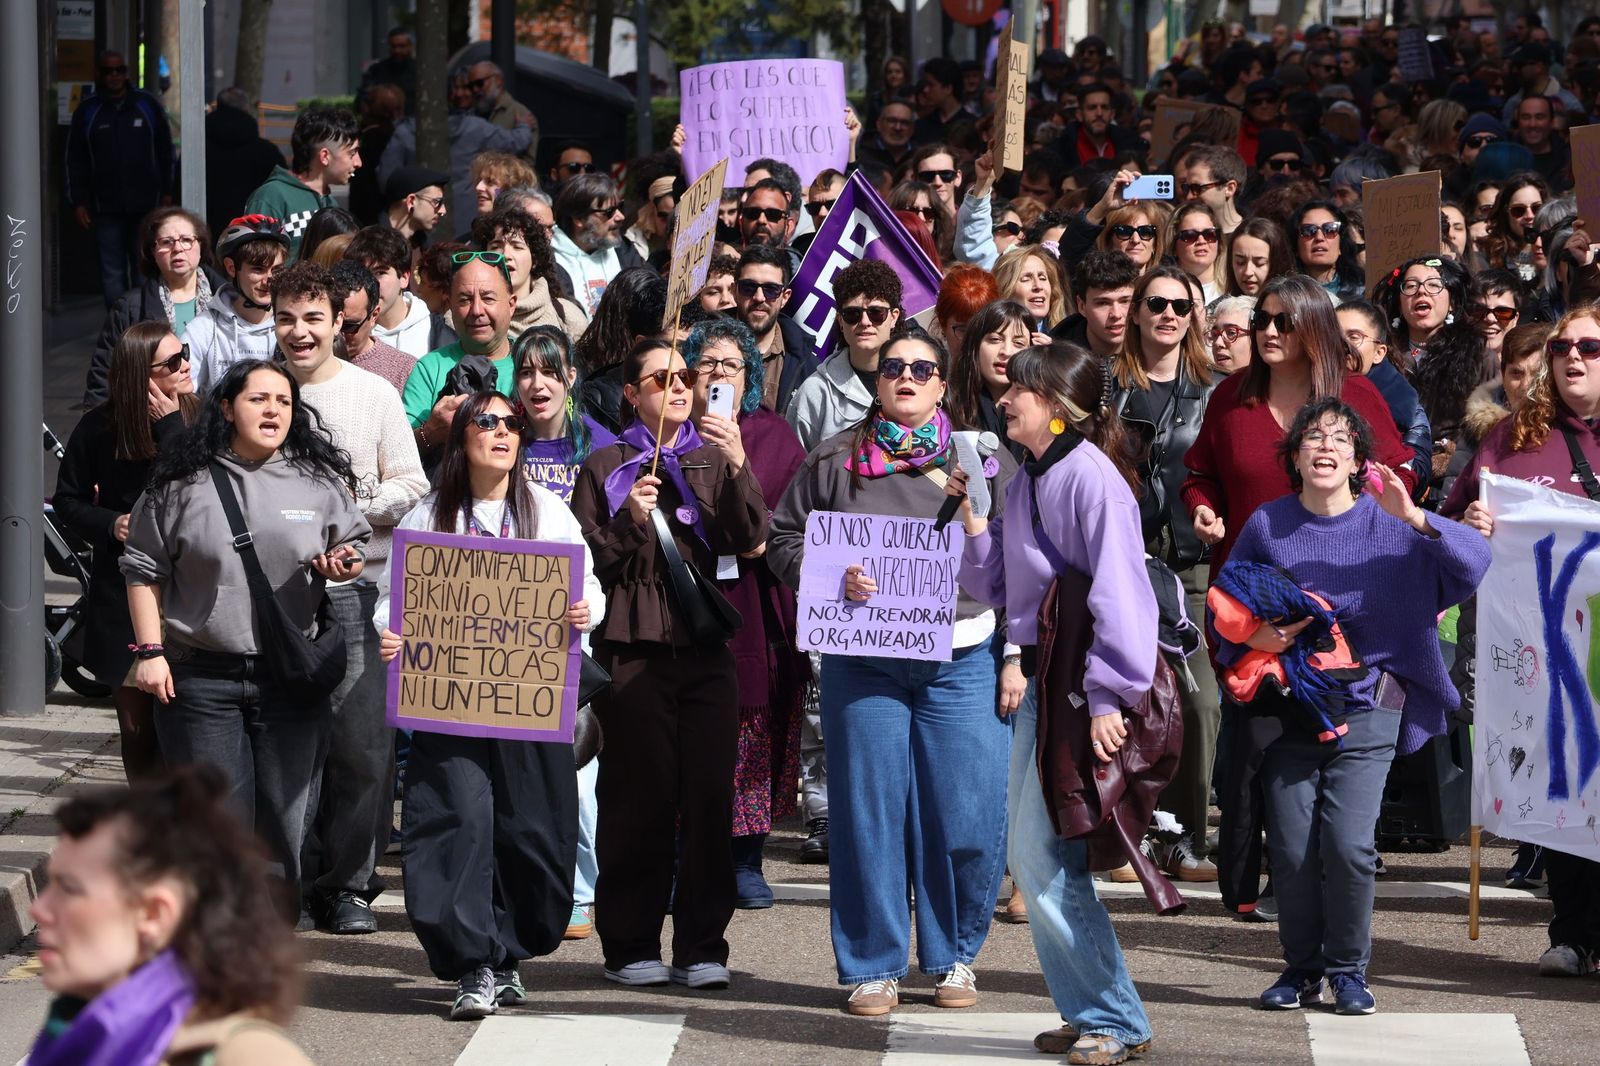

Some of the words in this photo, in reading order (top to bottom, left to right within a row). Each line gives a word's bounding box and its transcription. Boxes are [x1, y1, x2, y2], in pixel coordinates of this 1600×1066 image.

[745, 66, 779, 88] LAS
[788, 66, 827, 87] QUE
[697, 101, 722, 122] LO
[740, 96, 816, 119] SUFREN
[698, 131, 721, 153] EN
[729, 125, 835, 158] SILENCIO!
[839, 517, 873, 548] NOS
[405, 545, 453, 578] CON
[862, 556, 956, 603] ENFRENTADAS
[497, 586, 569, 621] VELO
[808, 605, 854, 623] NOS
[865, 605, 953, 626] TRENDRÁN
[402, 640, 434, 671] NO
[433, 646, 470, 675] ME
[472, 646, 560, 681] TOCAS
[432, 677, 474, 711] UN
[477, 681, 554, 717] PELO
